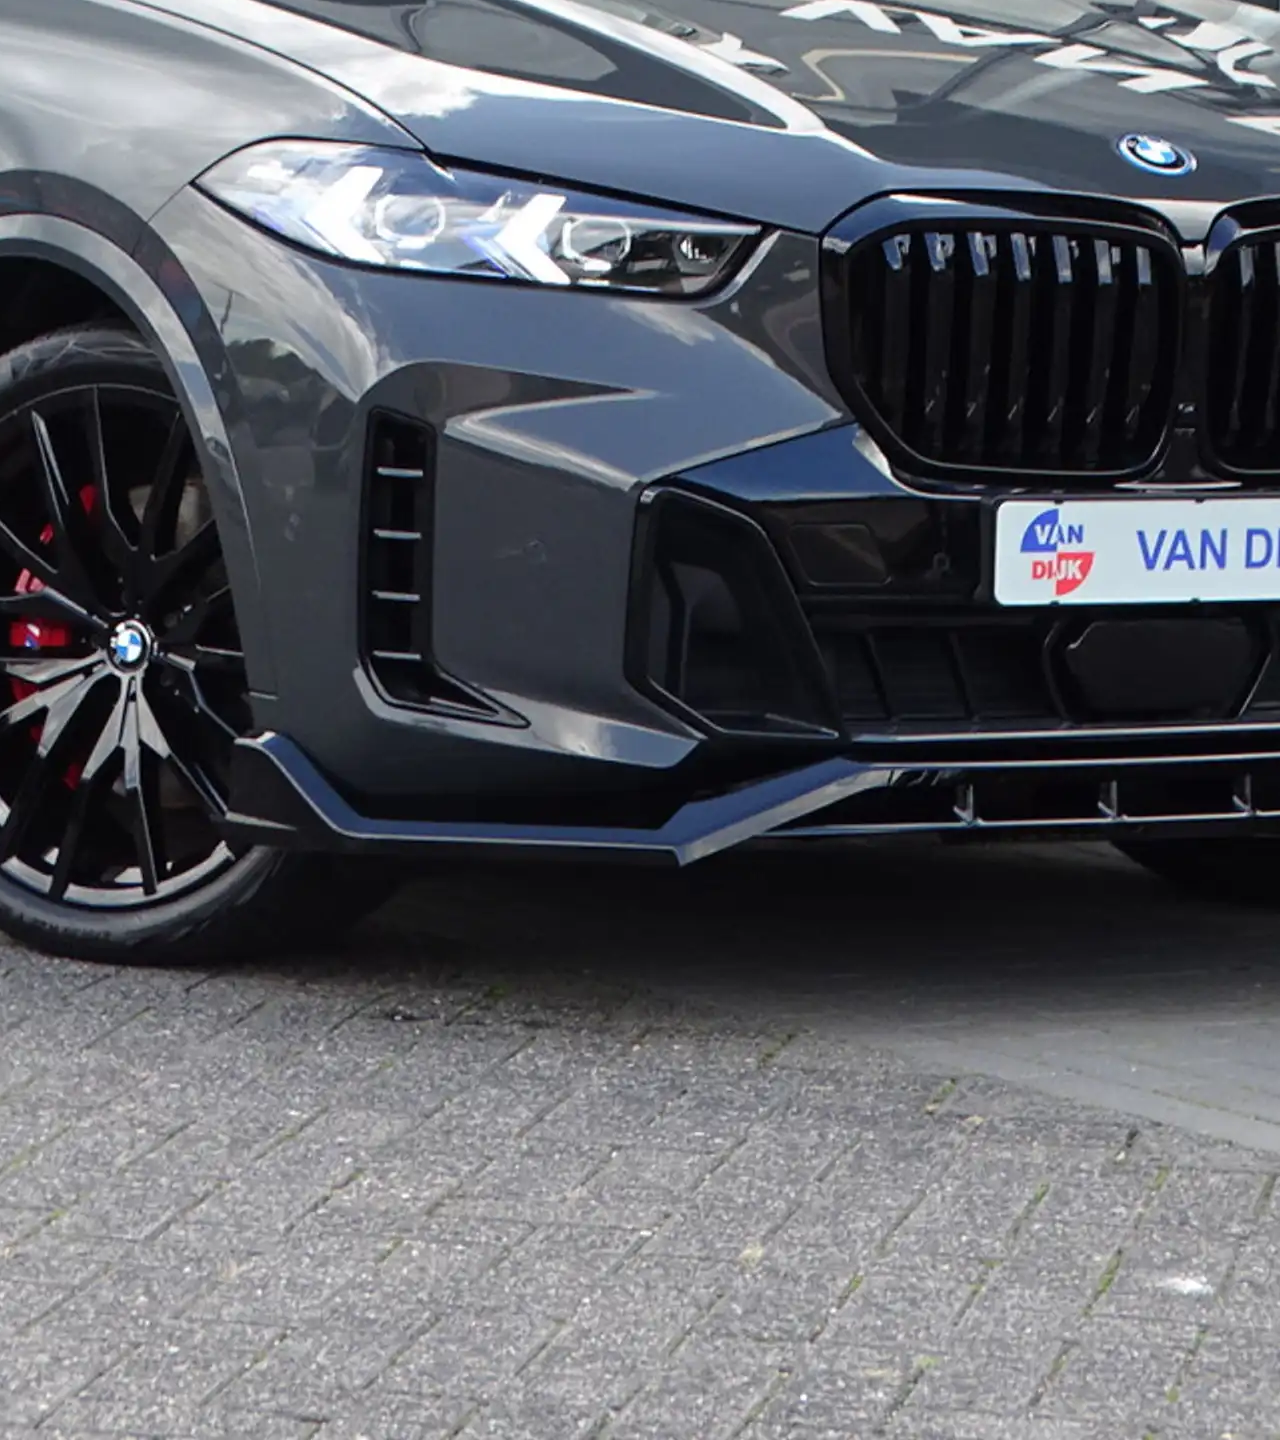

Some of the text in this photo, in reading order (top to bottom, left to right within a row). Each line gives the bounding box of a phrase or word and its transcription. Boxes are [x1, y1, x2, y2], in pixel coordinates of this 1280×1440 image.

[1034, 523, 1084, 545] VAN
[1136, 527, 1228, 571] VAN
[1031, 559, 1083, 580] DIJK
